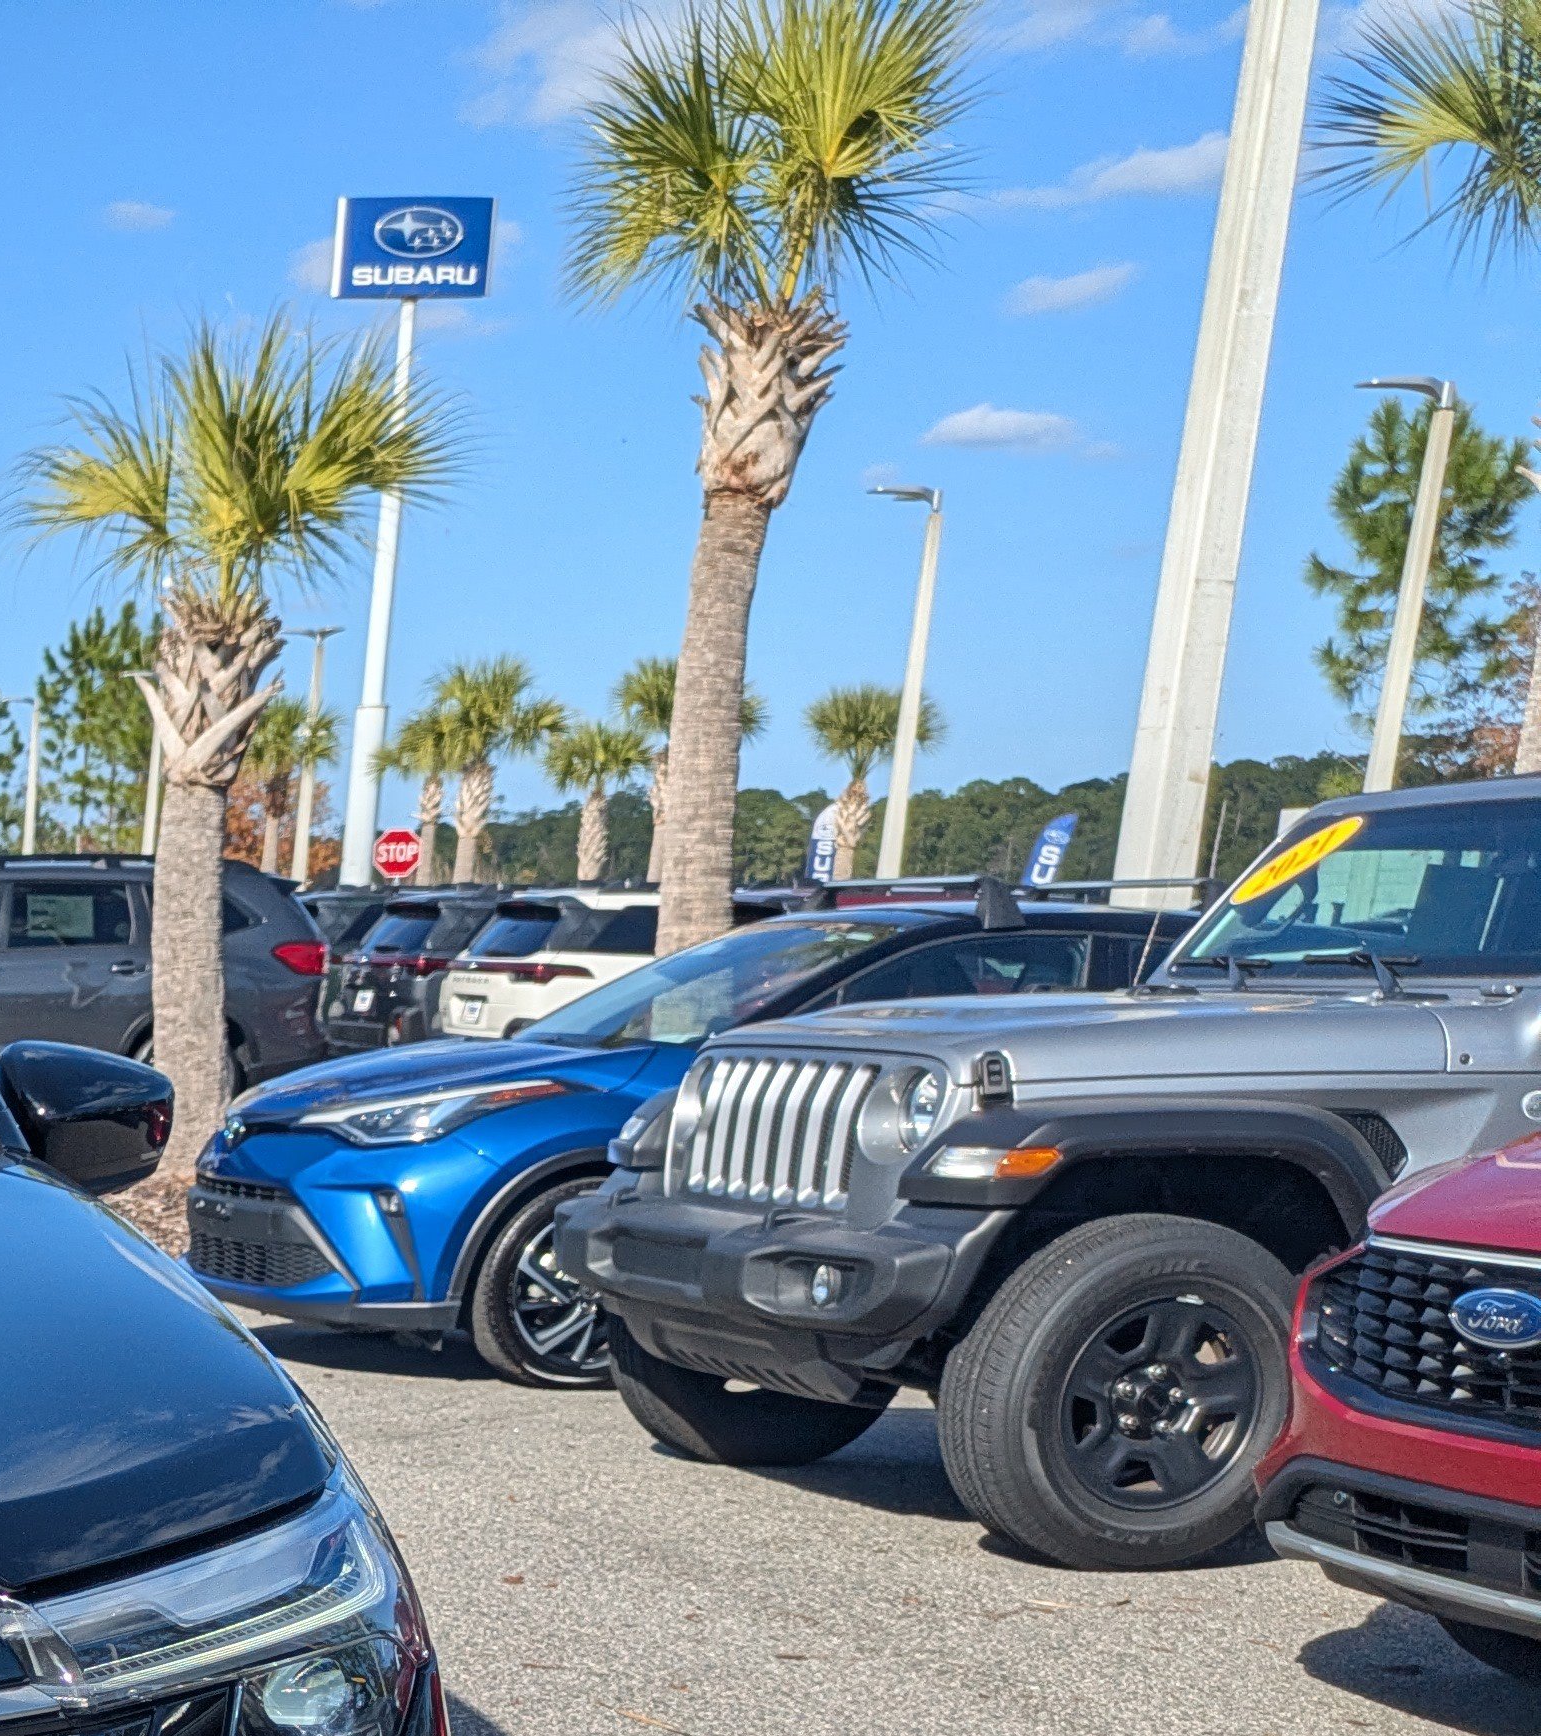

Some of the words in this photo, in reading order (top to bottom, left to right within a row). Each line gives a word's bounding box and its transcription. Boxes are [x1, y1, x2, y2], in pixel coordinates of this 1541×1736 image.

[352, 265, 478, 287] SUBARU
[376, 842, 419, 863] STOP
[1468, 1299, 1529, 1334] Ford
